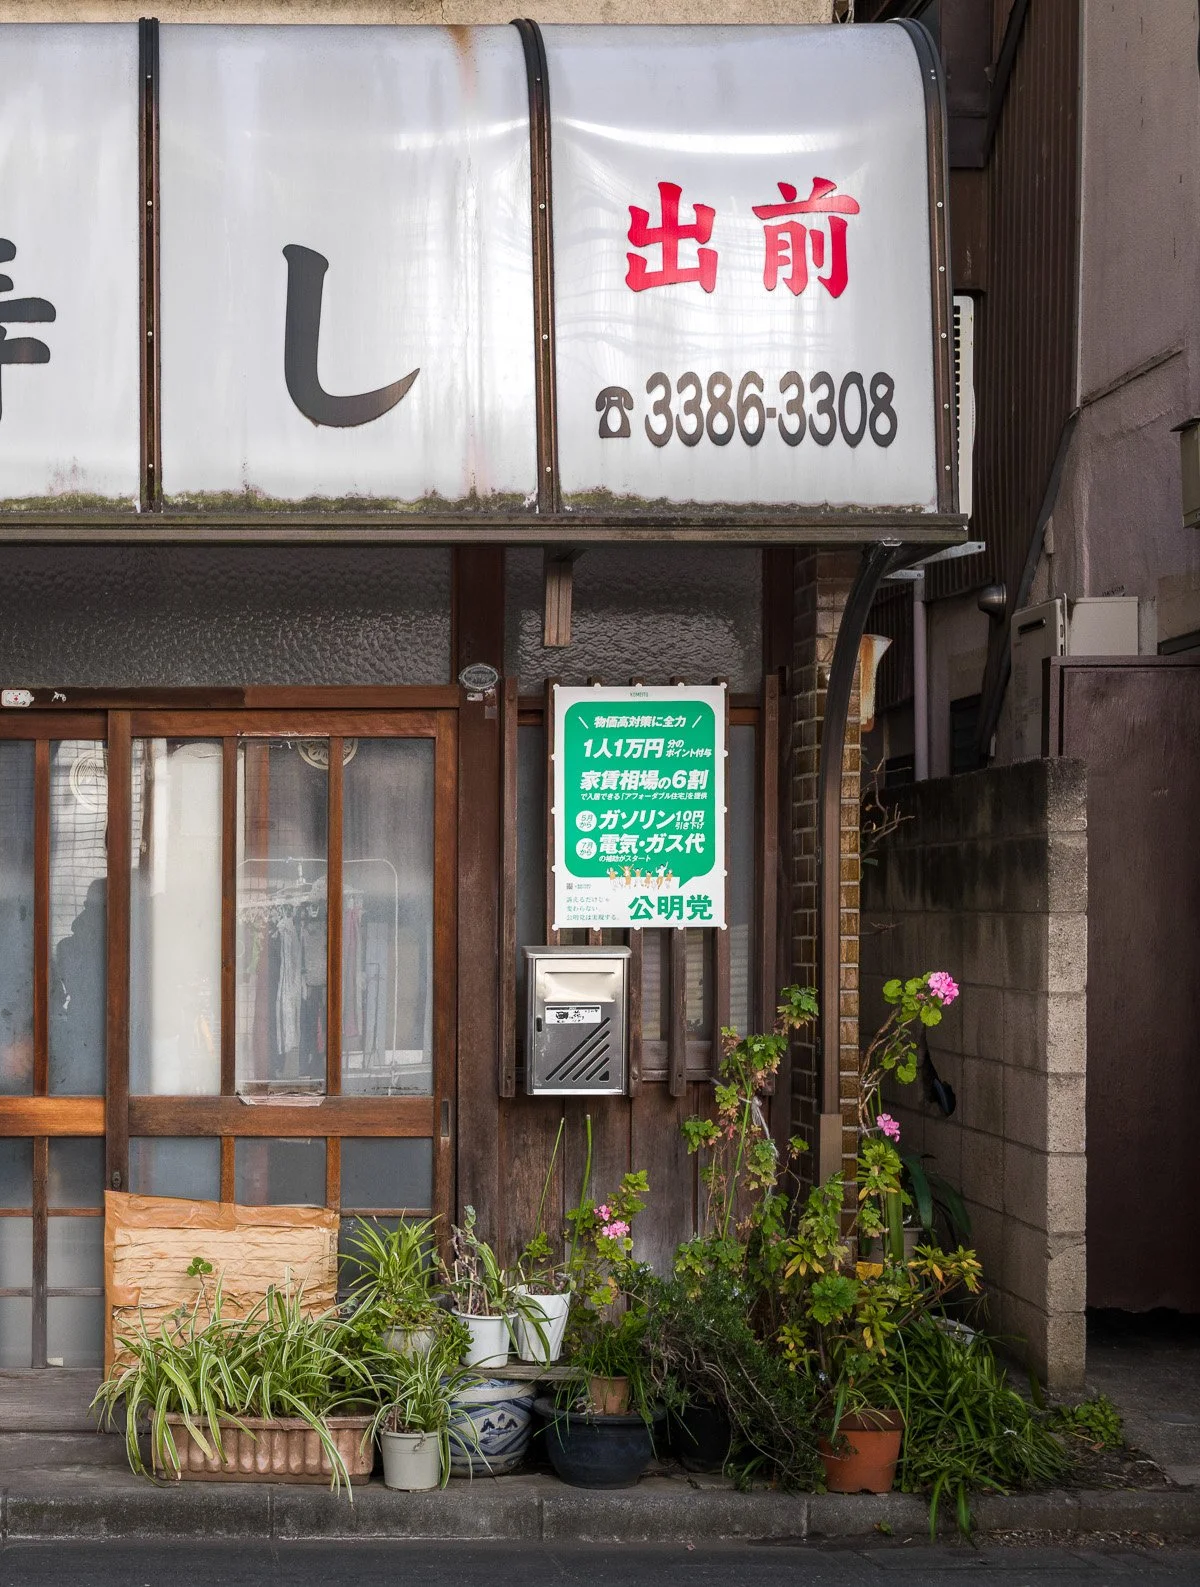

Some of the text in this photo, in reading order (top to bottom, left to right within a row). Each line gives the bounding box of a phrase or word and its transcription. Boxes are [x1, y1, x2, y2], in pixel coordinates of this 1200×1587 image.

[625, 177, 860, 298] 出前
[644, 370, 898, 448] 3386-3308
[593, 715, 687, 729] 物価高対策に全力
[583, 738, 665, 759] 1人1万円
[665, 748, 712, 758] ポイント付与
[667, 739, 685, 749] 分の
[580, 769, 710, 791] 家賃相場の6割
[598, 808, 676, 830] ガソリン
[674, 821, 705, 831] 引き下げ
[675, 810, 705, 822] 10円
[599, 832, 706, 855] 電気・ガス代
[627, 894, 714, 921] 公明党
